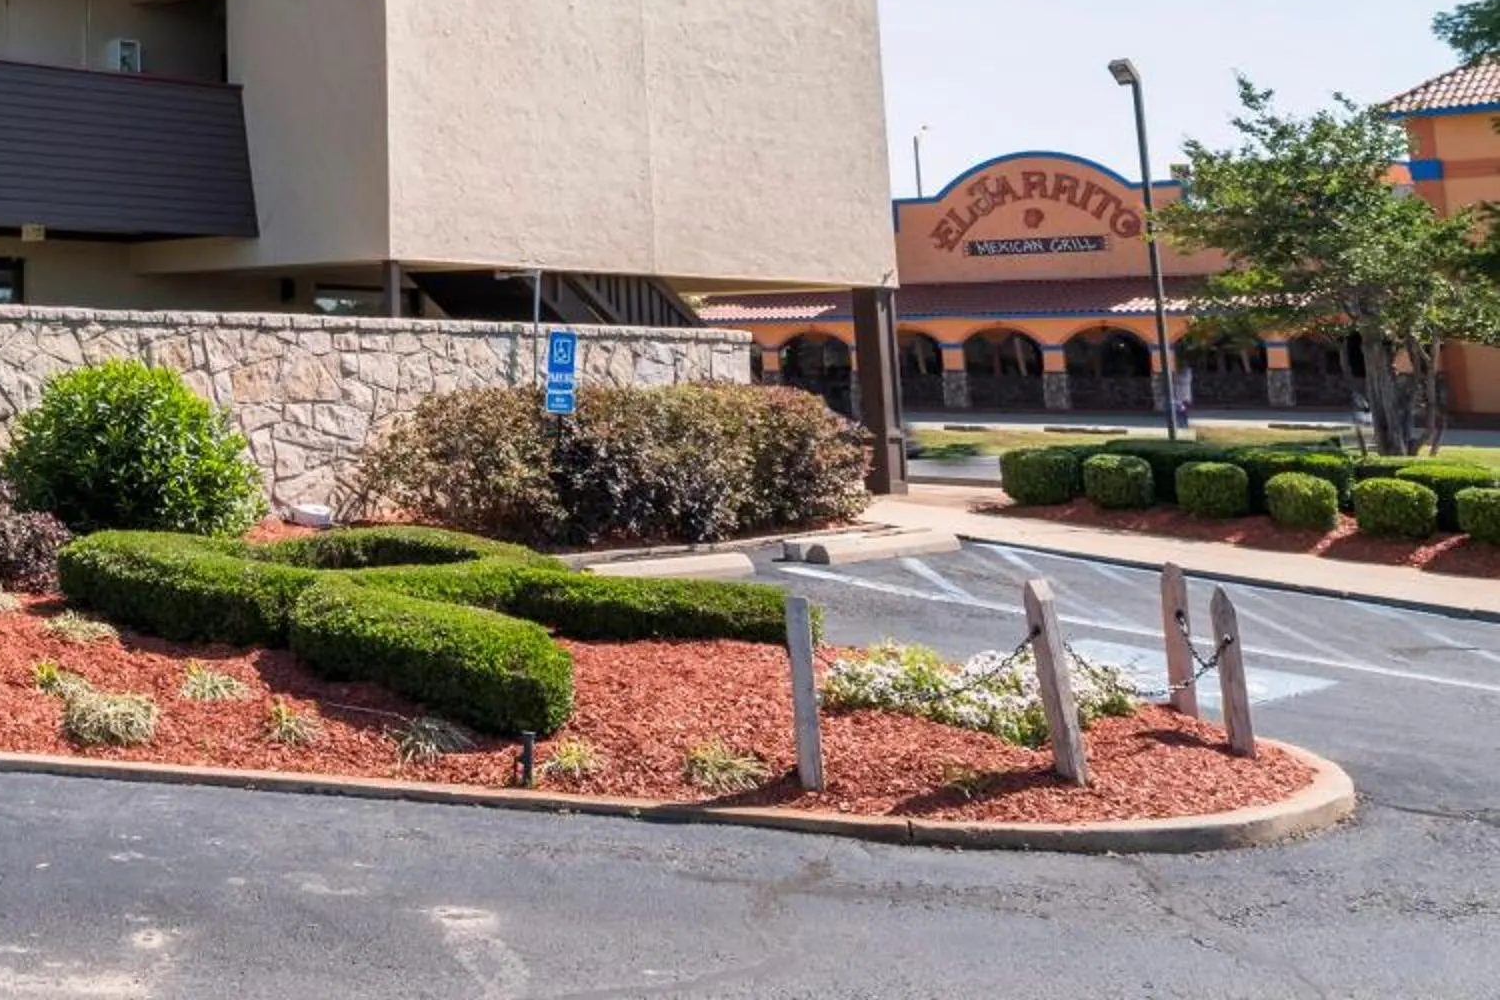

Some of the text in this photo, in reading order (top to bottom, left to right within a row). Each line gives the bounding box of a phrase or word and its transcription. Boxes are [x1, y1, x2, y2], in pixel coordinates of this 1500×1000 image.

[928, 206, 980, 252] EL
[975, 236, 1098, 255] MEXICAN GRILL
